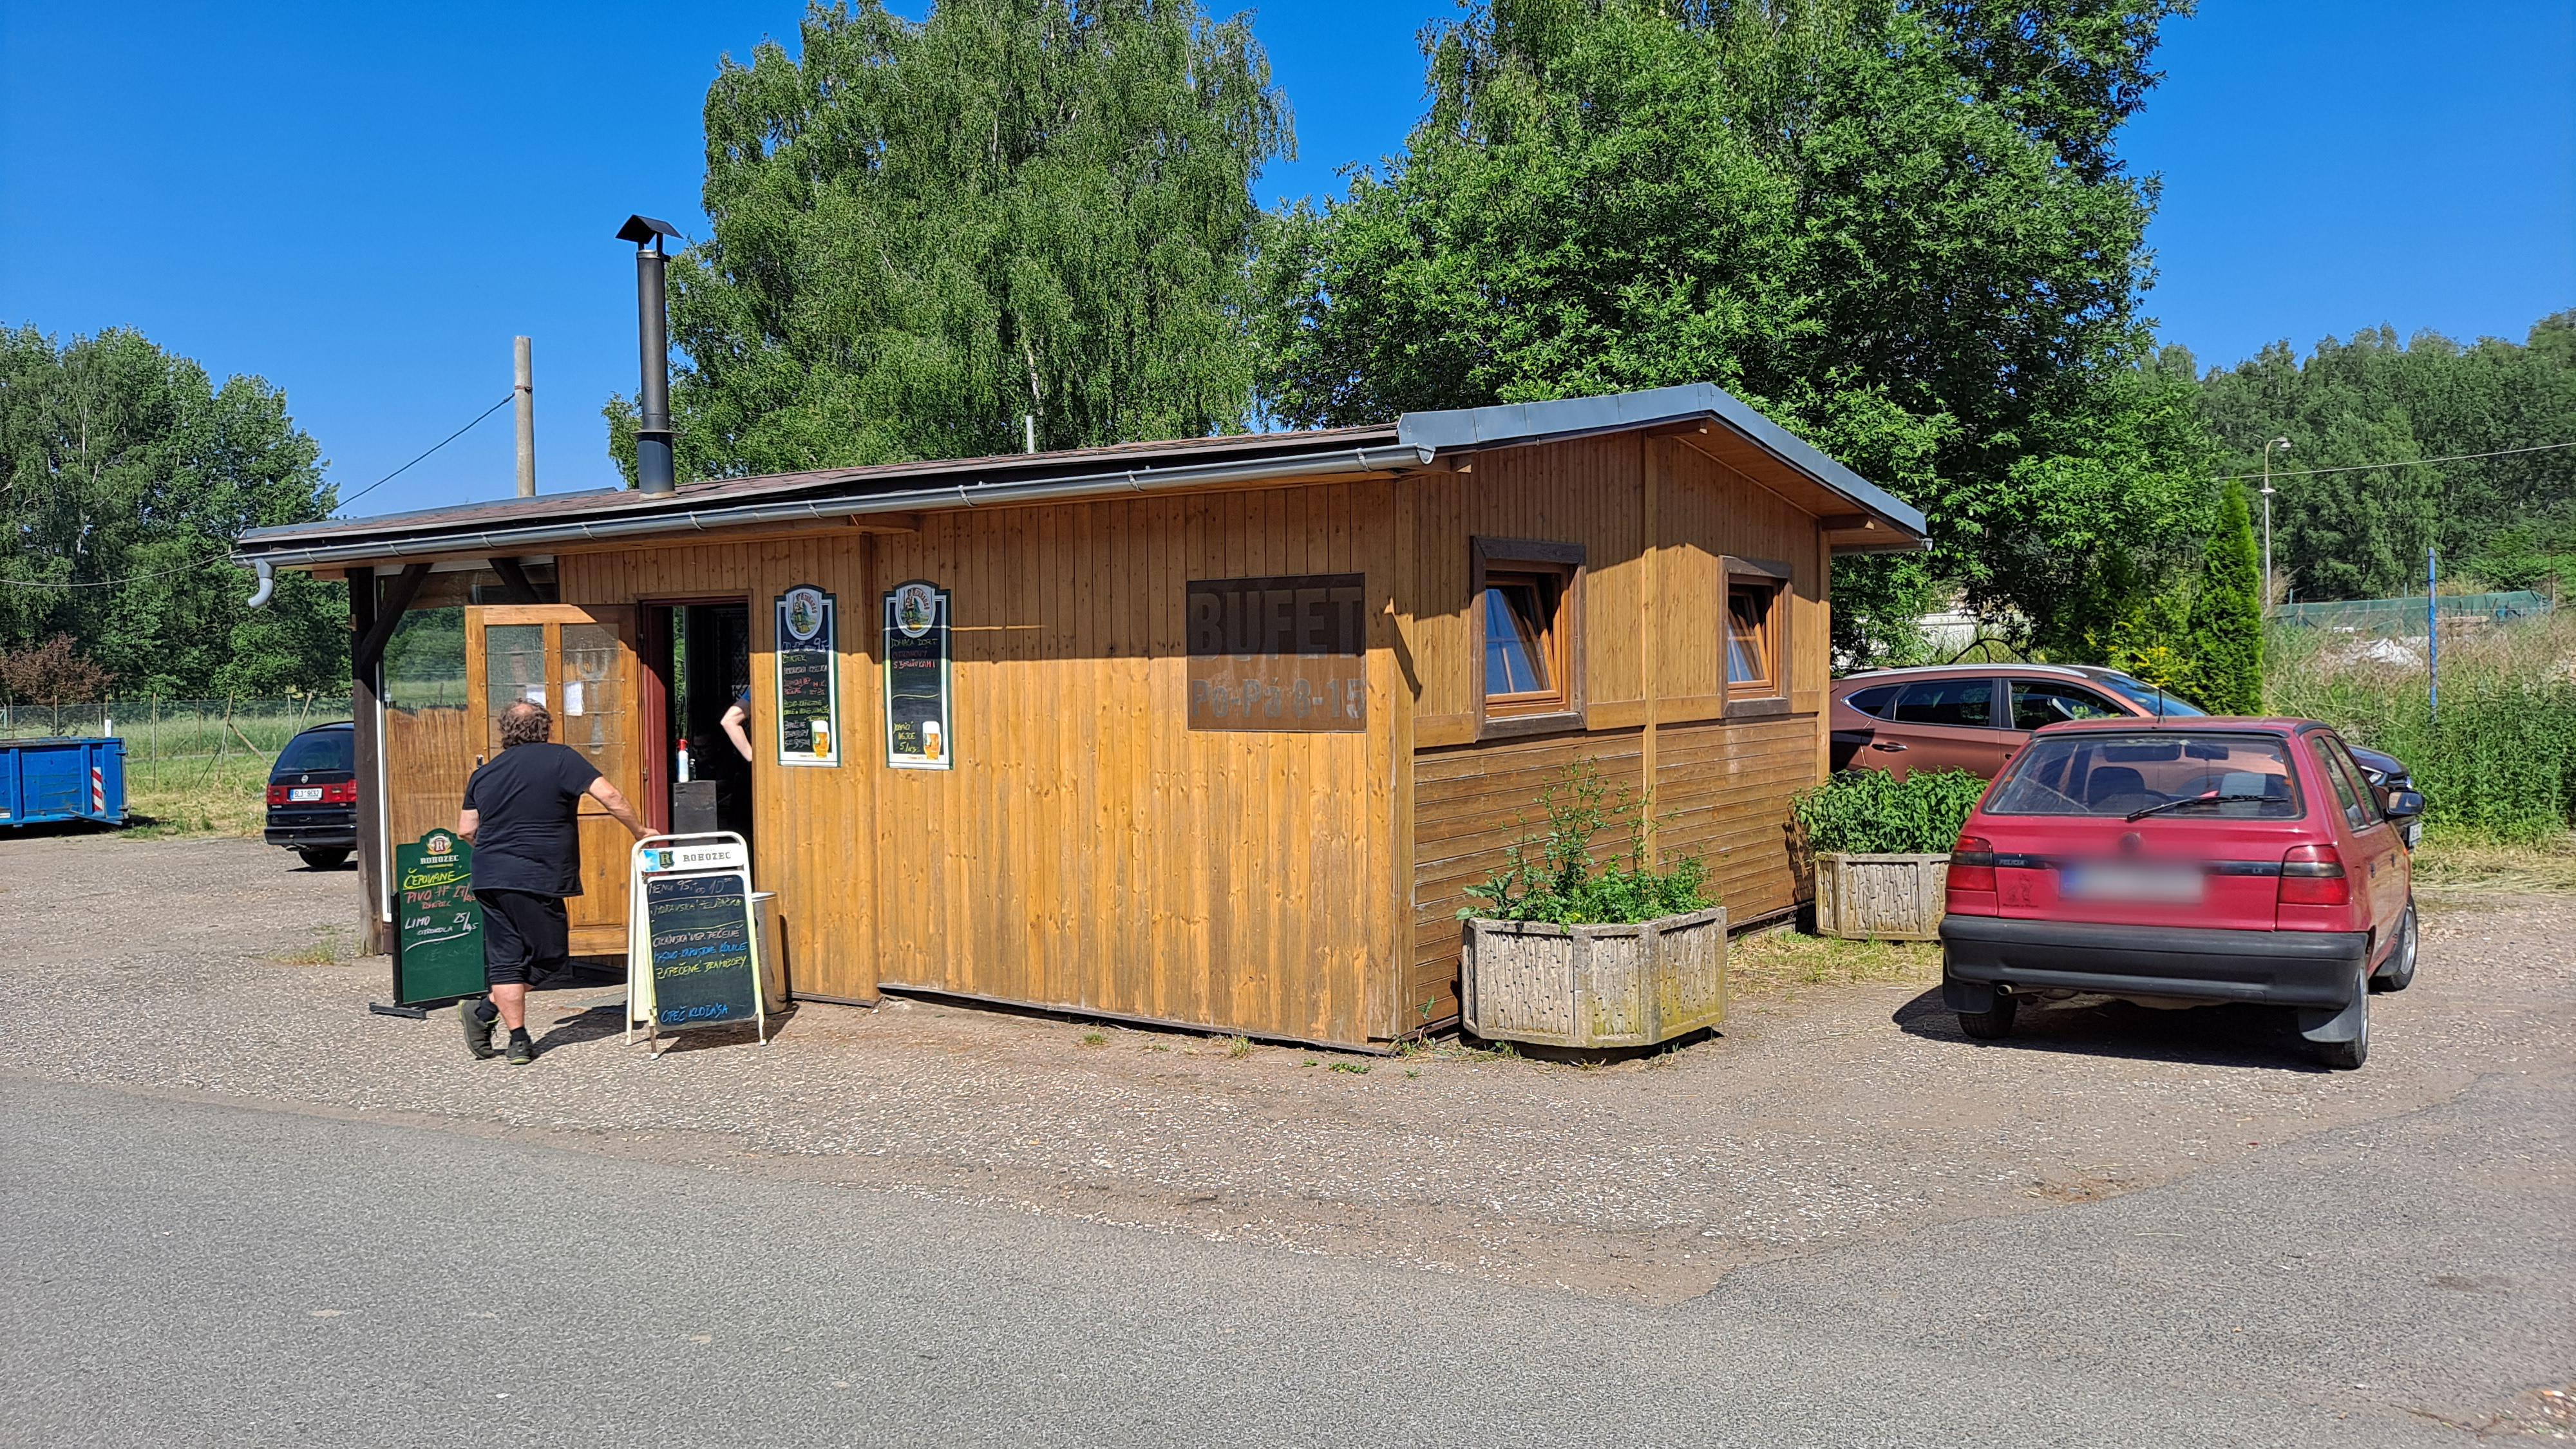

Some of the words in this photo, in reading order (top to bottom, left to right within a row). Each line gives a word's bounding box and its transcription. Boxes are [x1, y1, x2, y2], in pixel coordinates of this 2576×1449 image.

[1189, 587, 1362, 661] BUFET
[1191, 677, 1282, 719] Po-Pá
[1293, 679, 1365, 719] 8-15
[420, 855, 459, 864] ROHOZEC
[683, 851, 732, 862] ROHOZEC
[404, 889, 431, 904] PIVO
[404, 916, 431, 929] LIMO
